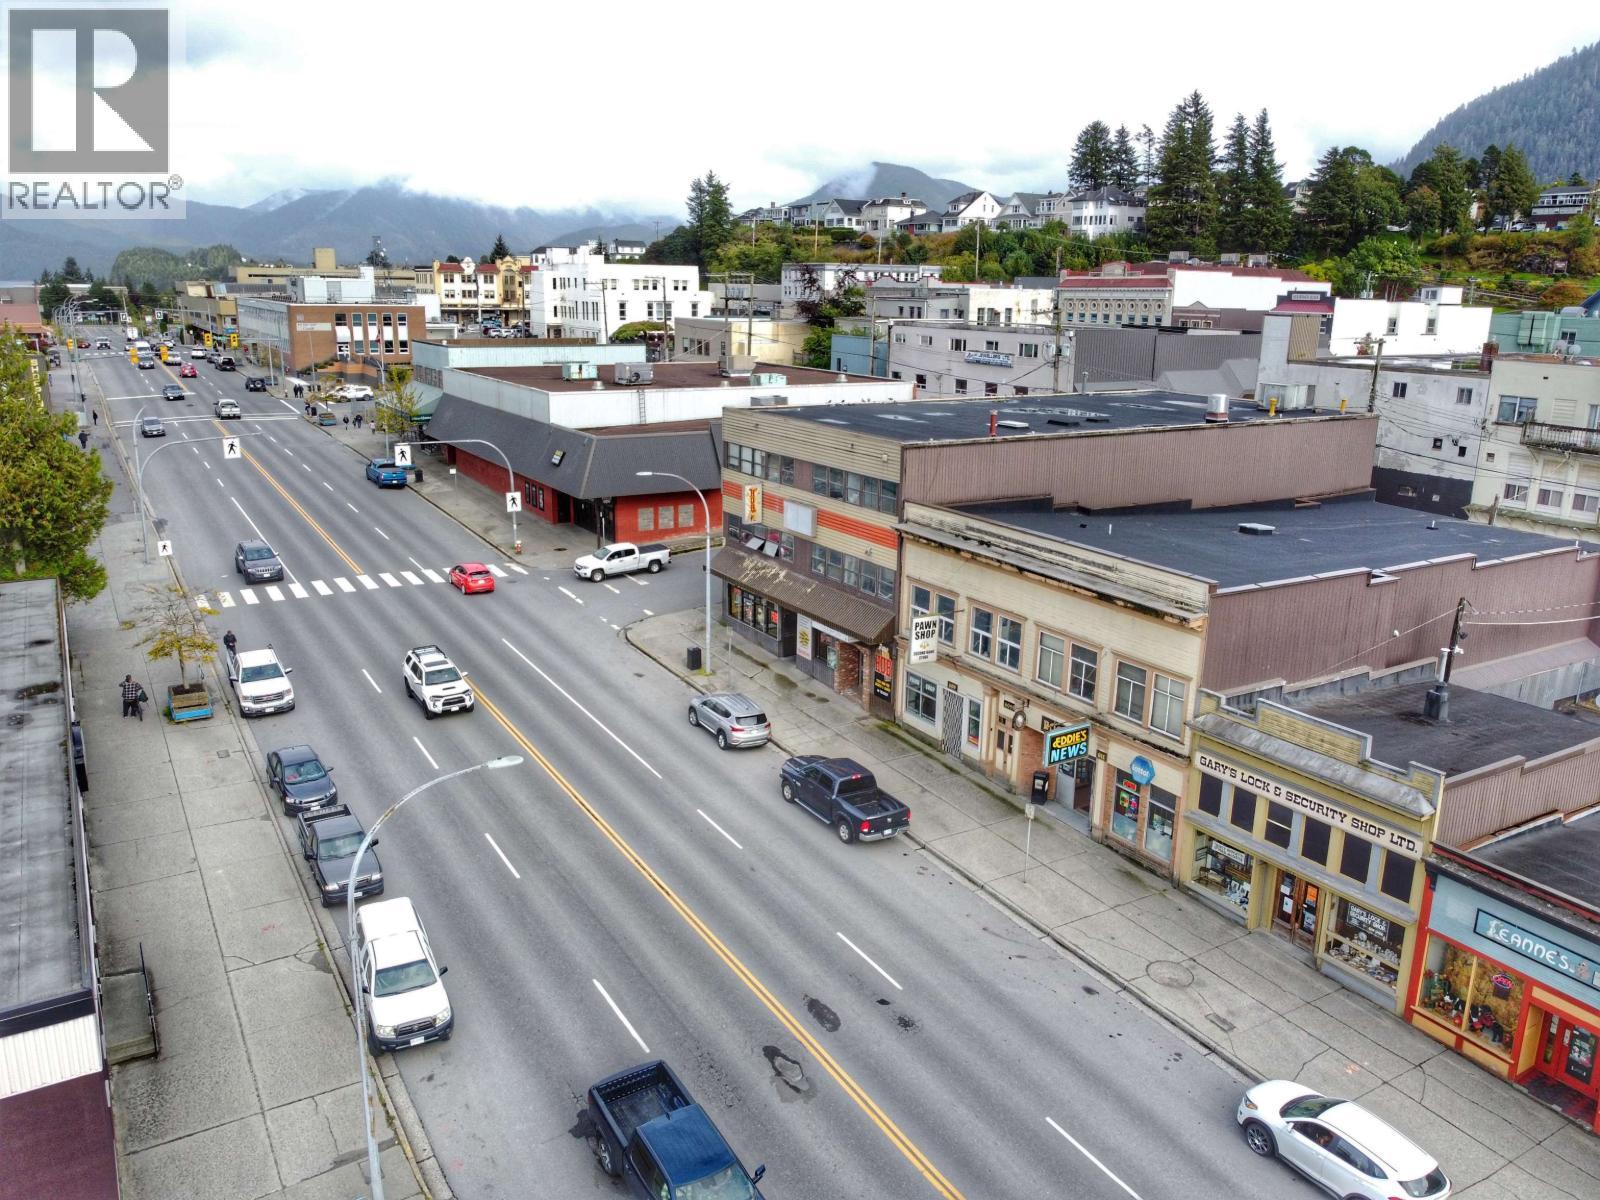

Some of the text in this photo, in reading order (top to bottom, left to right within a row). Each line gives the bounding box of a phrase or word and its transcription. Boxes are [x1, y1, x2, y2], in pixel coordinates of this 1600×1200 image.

[914, 620, 937, 631] PAWN
[914, 629, 936, 641] SHOP
[876, 655, 892, 677] HUB
[1052, 730, 1088, 748] EDDIE'S
[1050, 742, 1088, 763] NEWS
[1199, 755, 1418, 854] GARY'S LOCK & SECURITY SHOP LTD.
